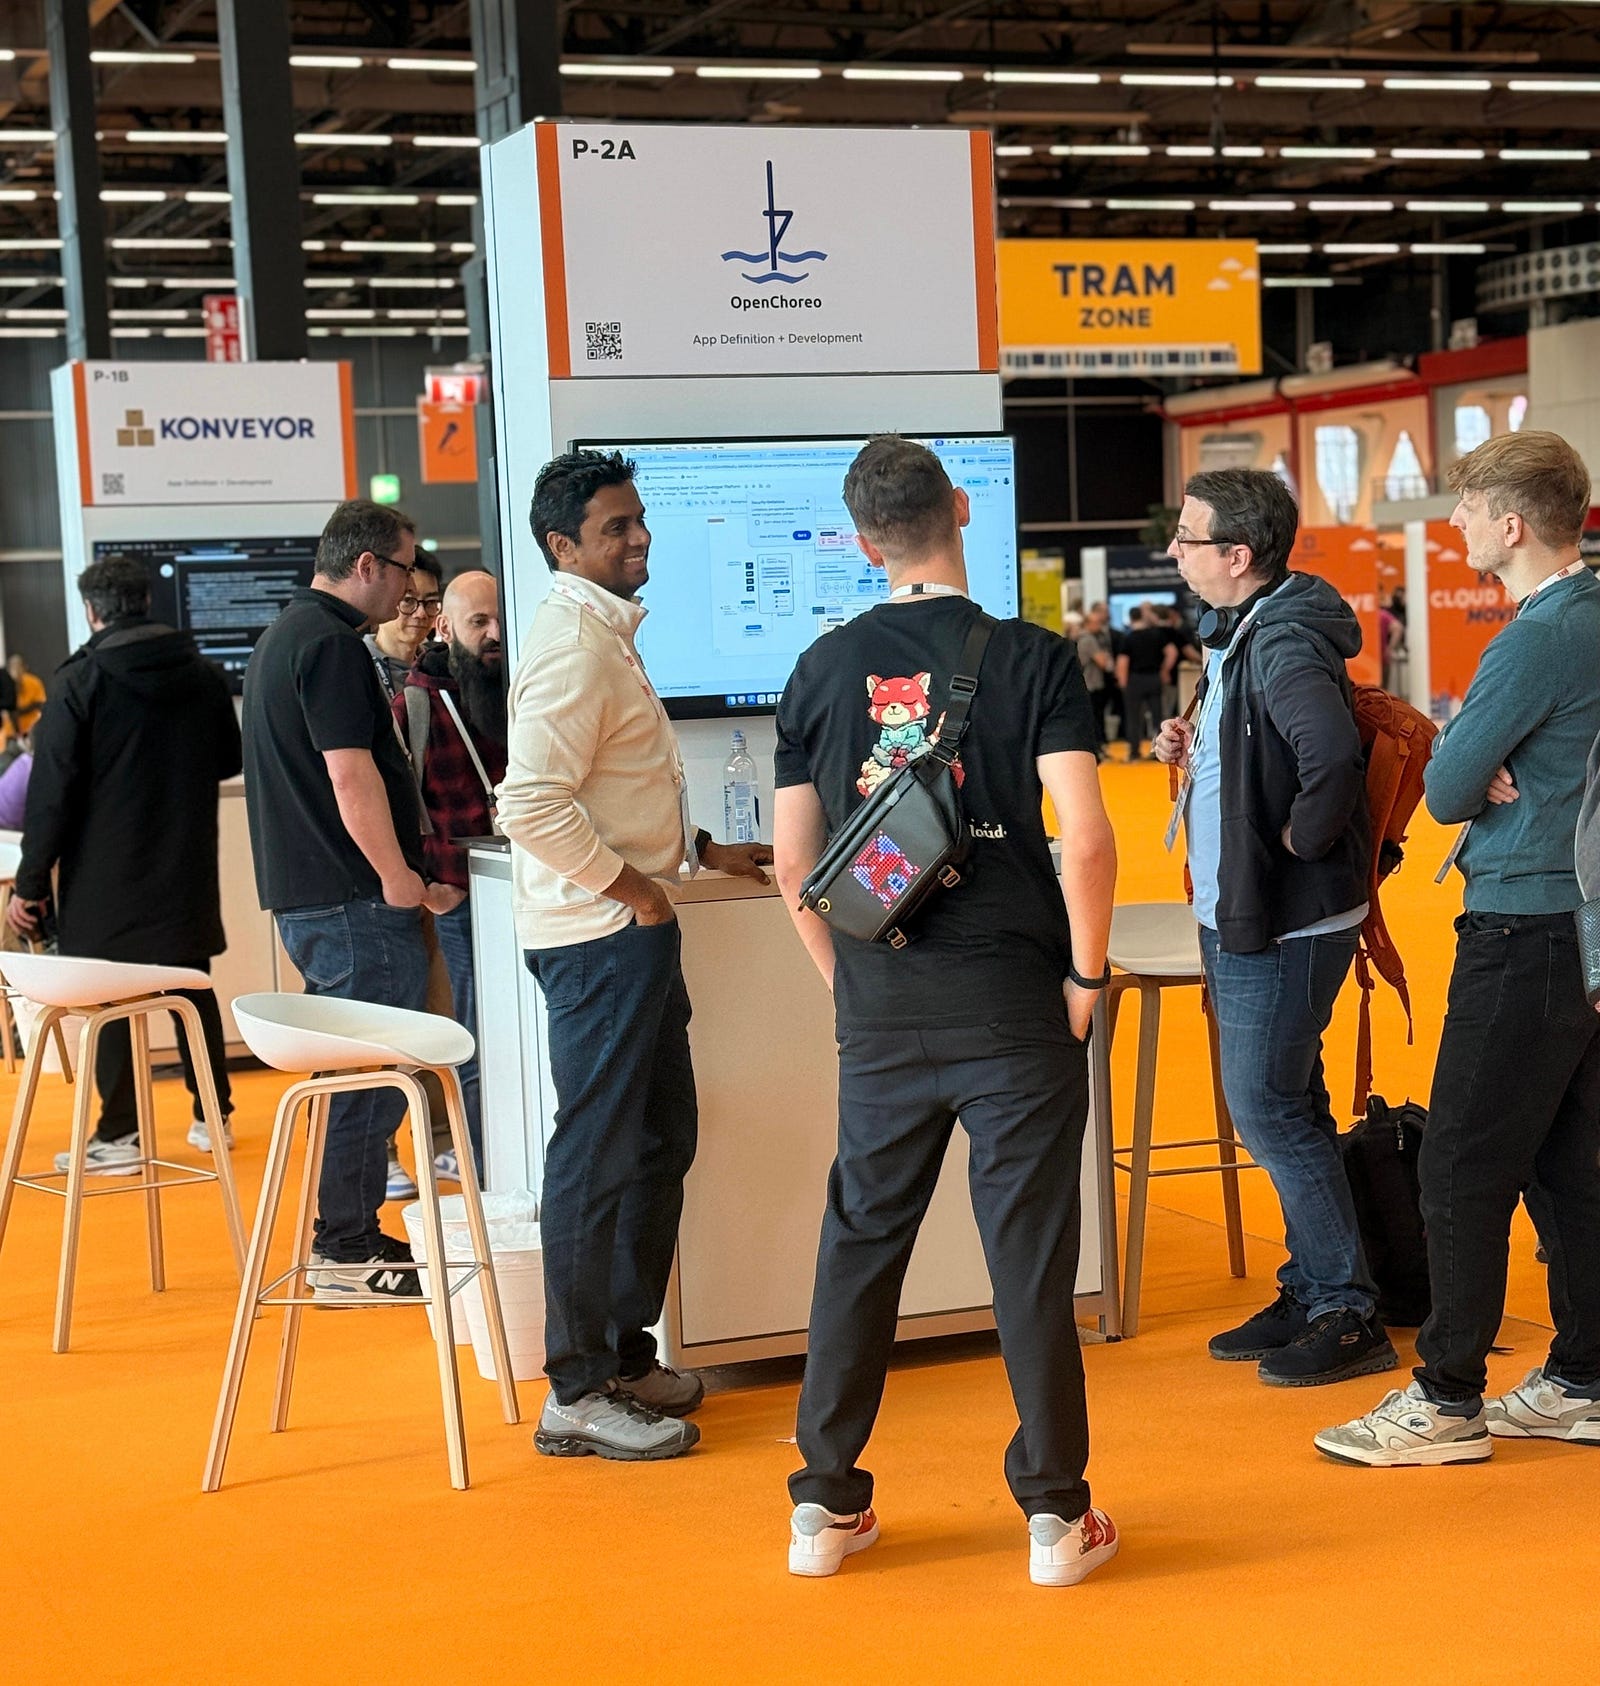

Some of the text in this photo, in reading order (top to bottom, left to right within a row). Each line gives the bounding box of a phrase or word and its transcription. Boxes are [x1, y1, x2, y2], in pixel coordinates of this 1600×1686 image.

[571, 139, 637, 160] P-2A
[1052, 263, 1175, 297] TRAM
[730, 295, 822, 312] OpenChoreo
[1079, 307, 1152, 328] ZONE
[692, 333, 717, 347] App
[720, 332, 775, 345] Definition
[788, 331, 863, 346] Development
[93, 370, 129, 383] P-1B
[160, 416, 315, 440] KONVEYOR
[1430, 588, 1499, 609] CLOUD
